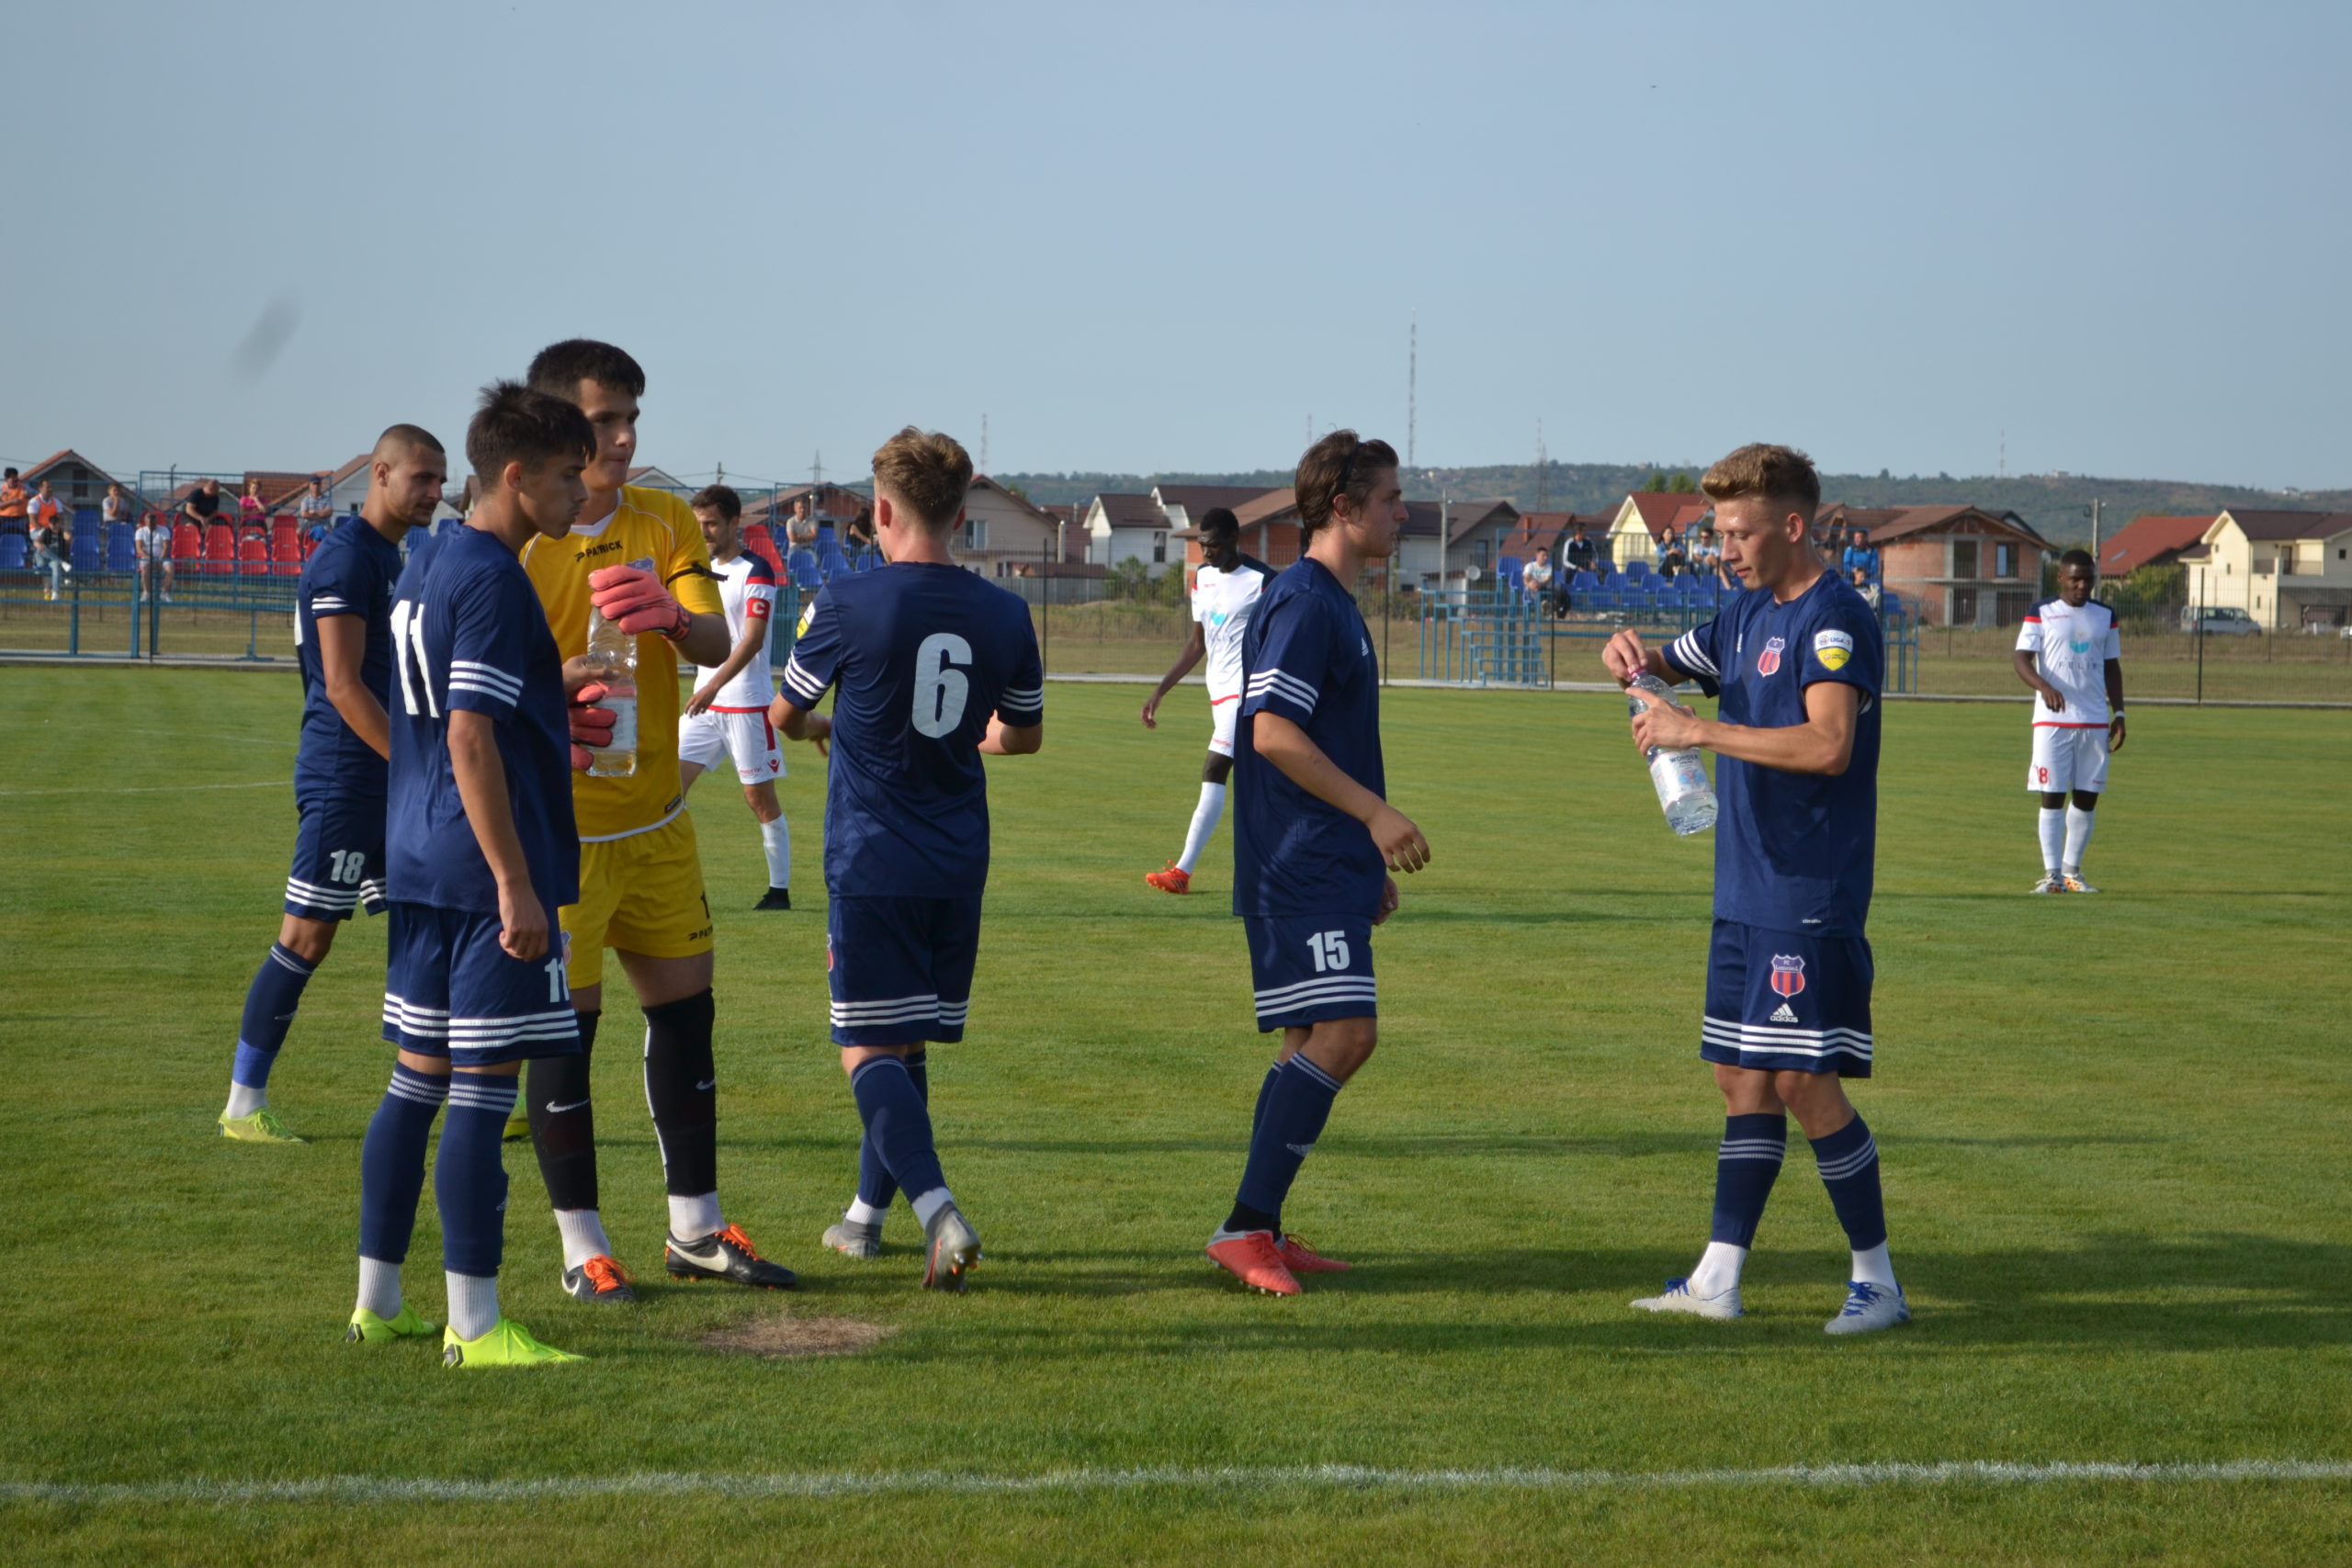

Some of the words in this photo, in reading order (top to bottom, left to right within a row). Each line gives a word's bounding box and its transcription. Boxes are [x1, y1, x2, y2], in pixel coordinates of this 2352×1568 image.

[585, 540, 623, 558] PATRICK
[752, 601, 765, 615] C
[390, 599, 440, 718] 11
[911, 632, 973, 739] 6
[330, 850, 366, 884] 18
[1306, 930, 1351, 973] 15
[544, 957, 570, 1003] 11
[1770, 1015, 1799, 1023] adidas
